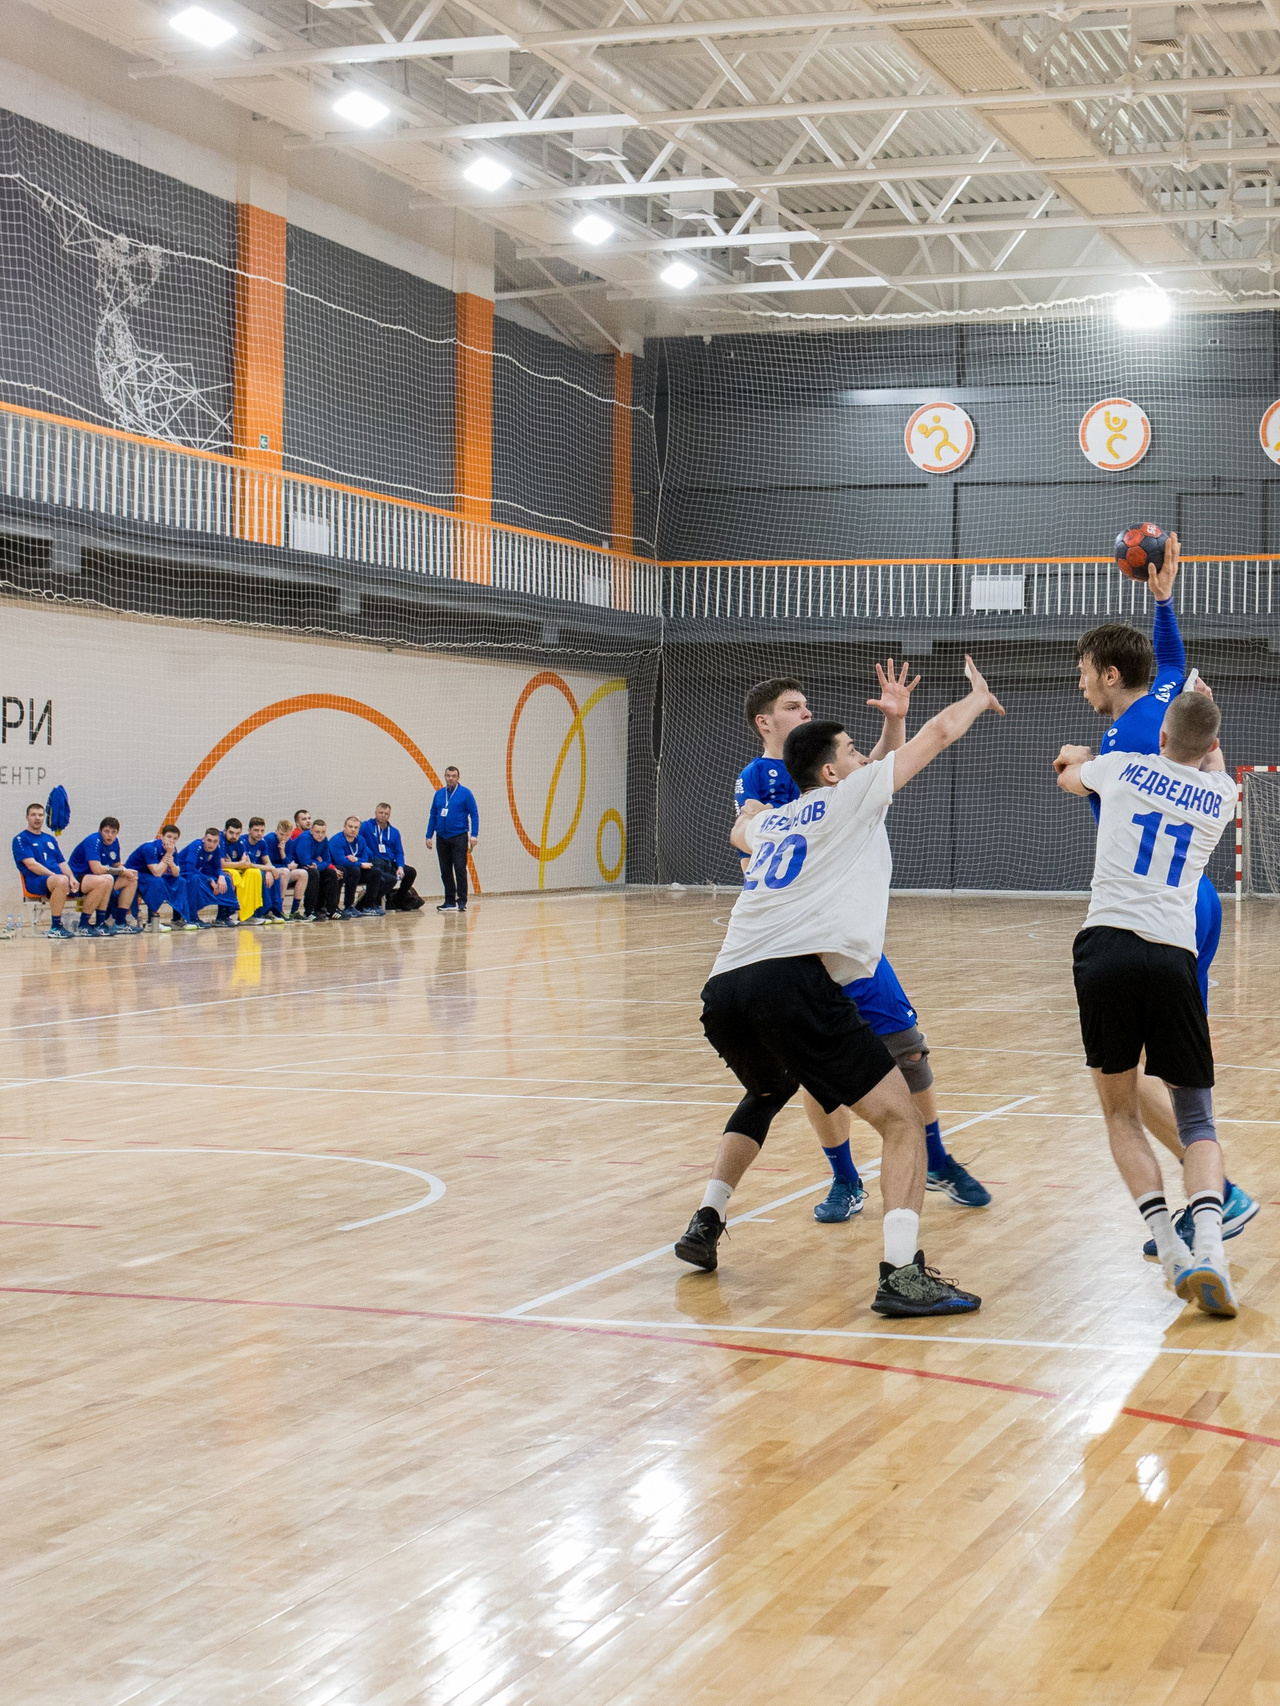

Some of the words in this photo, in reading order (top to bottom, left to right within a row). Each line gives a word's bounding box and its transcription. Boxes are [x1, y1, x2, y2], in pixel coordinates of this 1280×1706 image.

[1118, 762, 1224, 818] МЕДВЕДКОВ
[743, 834, 807, 891] 20
[1131, 811, 1194, 888] 11
